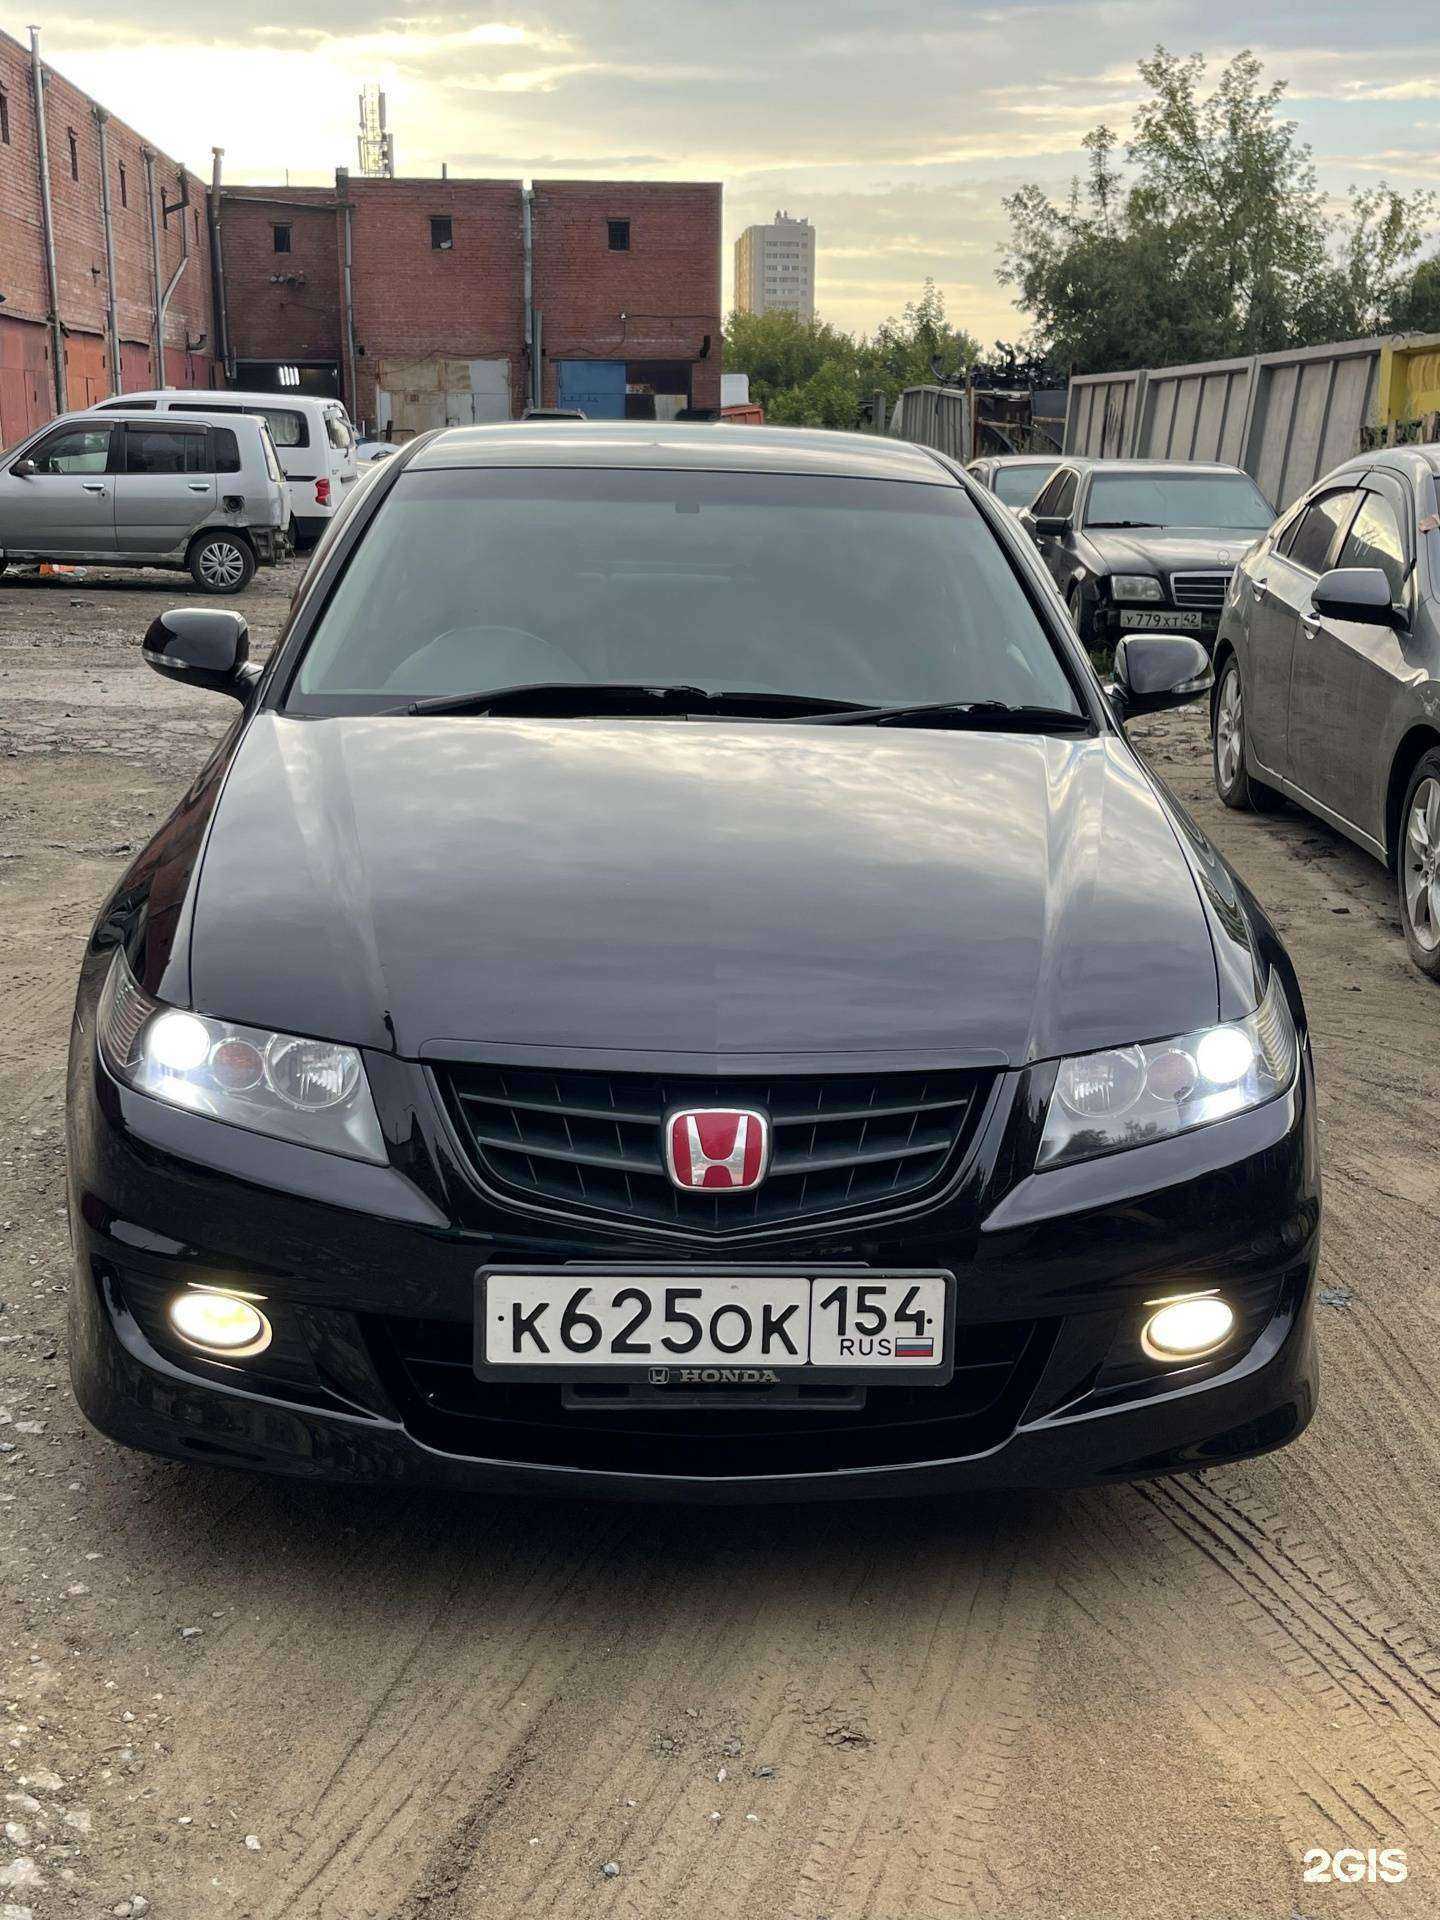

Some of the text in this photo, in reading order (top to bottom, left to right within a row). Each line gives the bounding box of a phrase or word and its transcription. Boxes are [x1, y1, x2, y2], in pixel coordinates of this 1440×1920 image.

[1183, 613, 1197, 624] 42
[512, 1285, 926, 1354] К625ОК 154
[840, 1338, 893, 1357] RUS
[680, 1369, 781, 1383] HONDA
